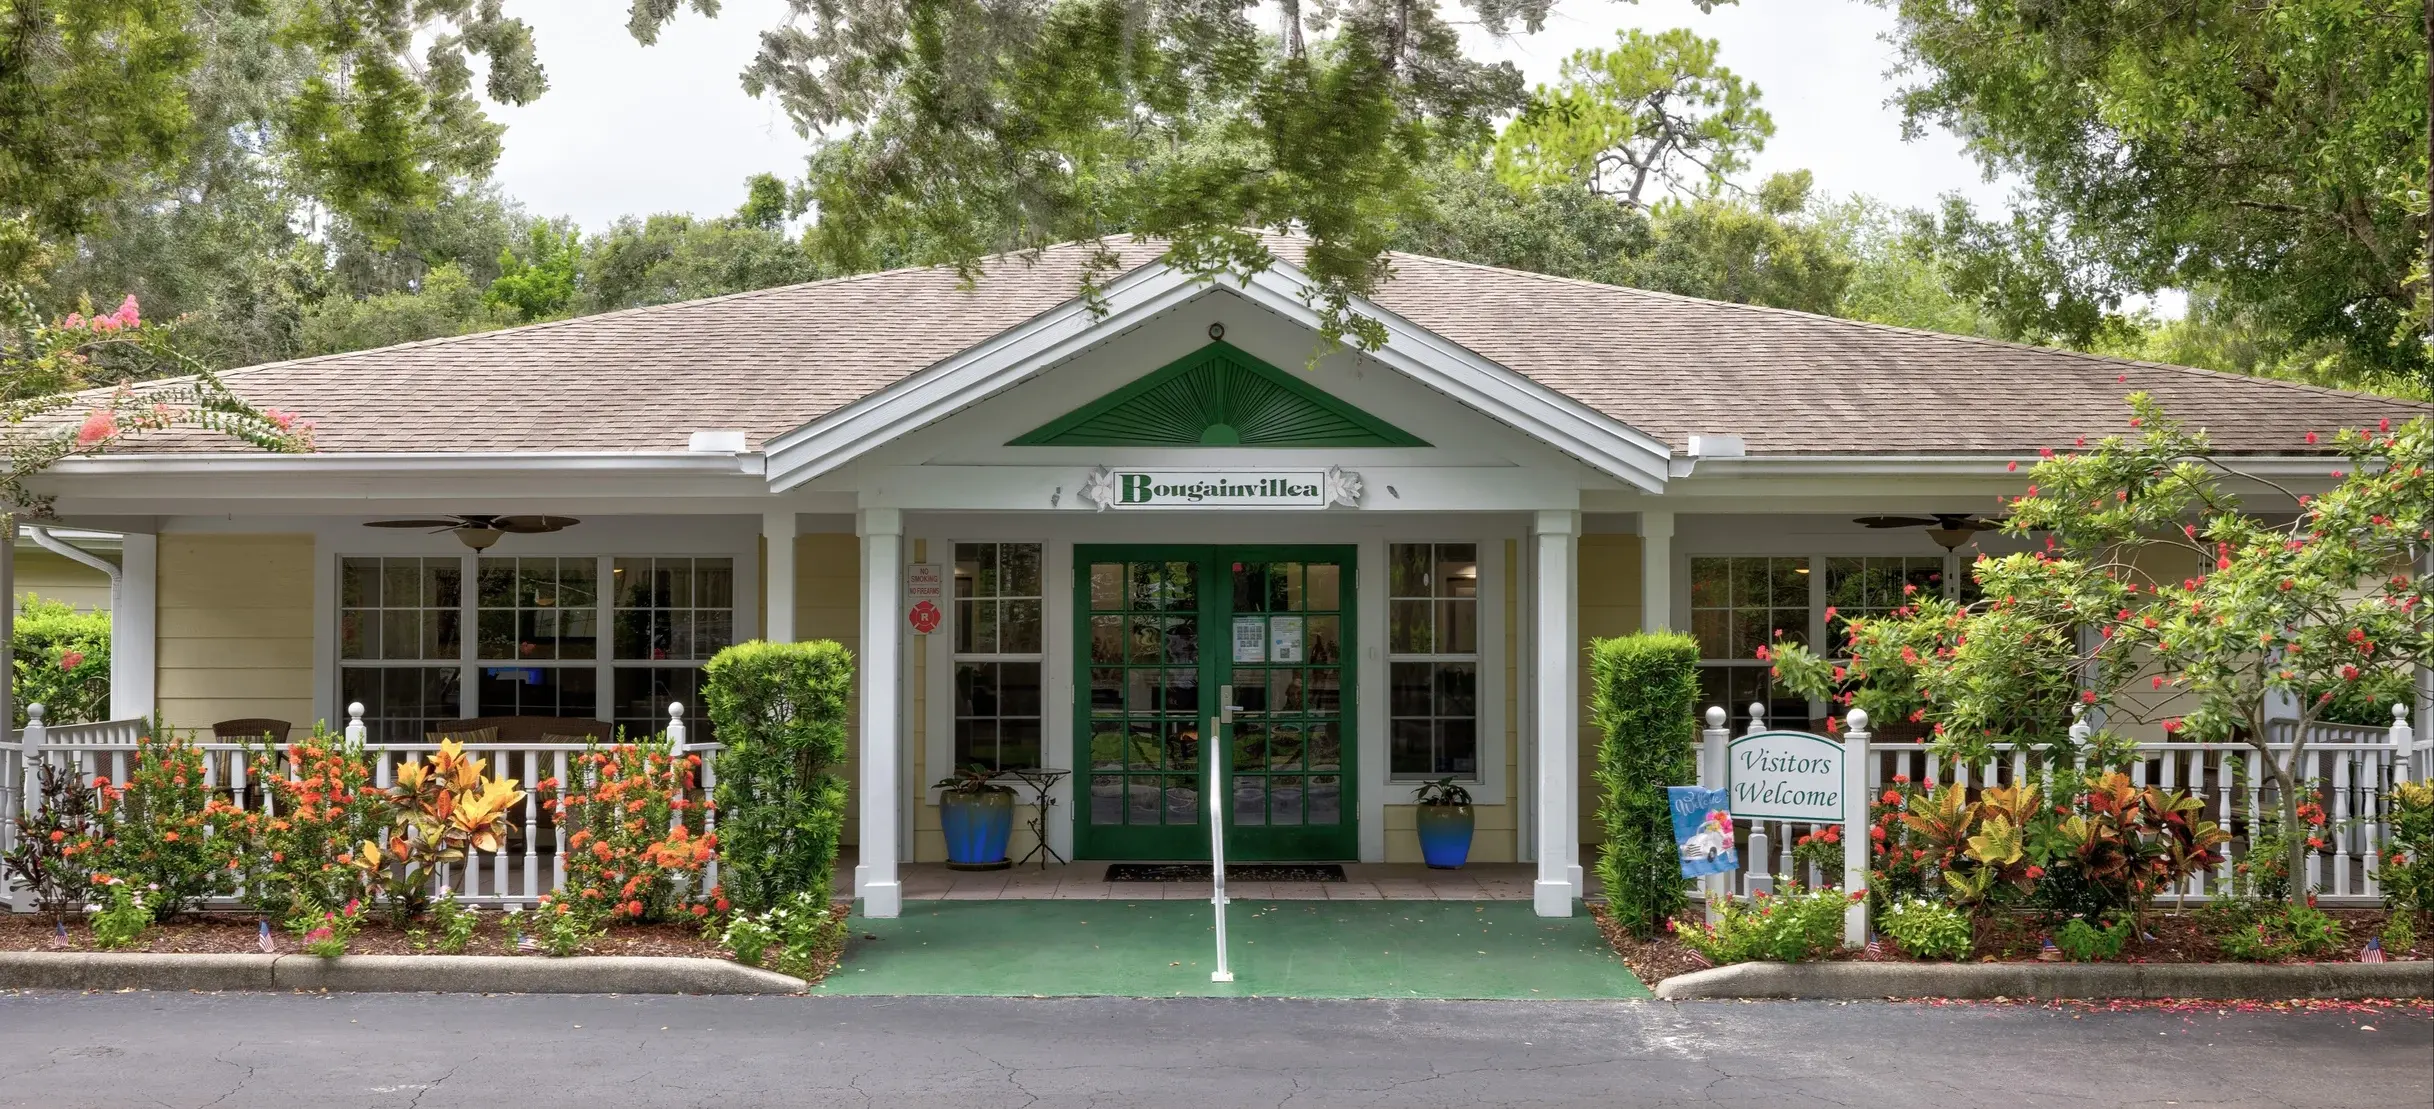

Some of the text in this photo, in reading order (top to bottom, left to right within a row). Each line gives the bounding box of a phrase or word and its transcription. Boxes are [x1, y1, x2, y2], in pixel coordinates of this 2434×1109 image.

[1119, 474, 1319, 503] Bougainvillea
[921, 613, 928, 621] R
[1740, 748, 1832, 774] Visitors
[1675, 791, 1722, 816] Welce
[1734, 780, 1838, 806] Welcome
